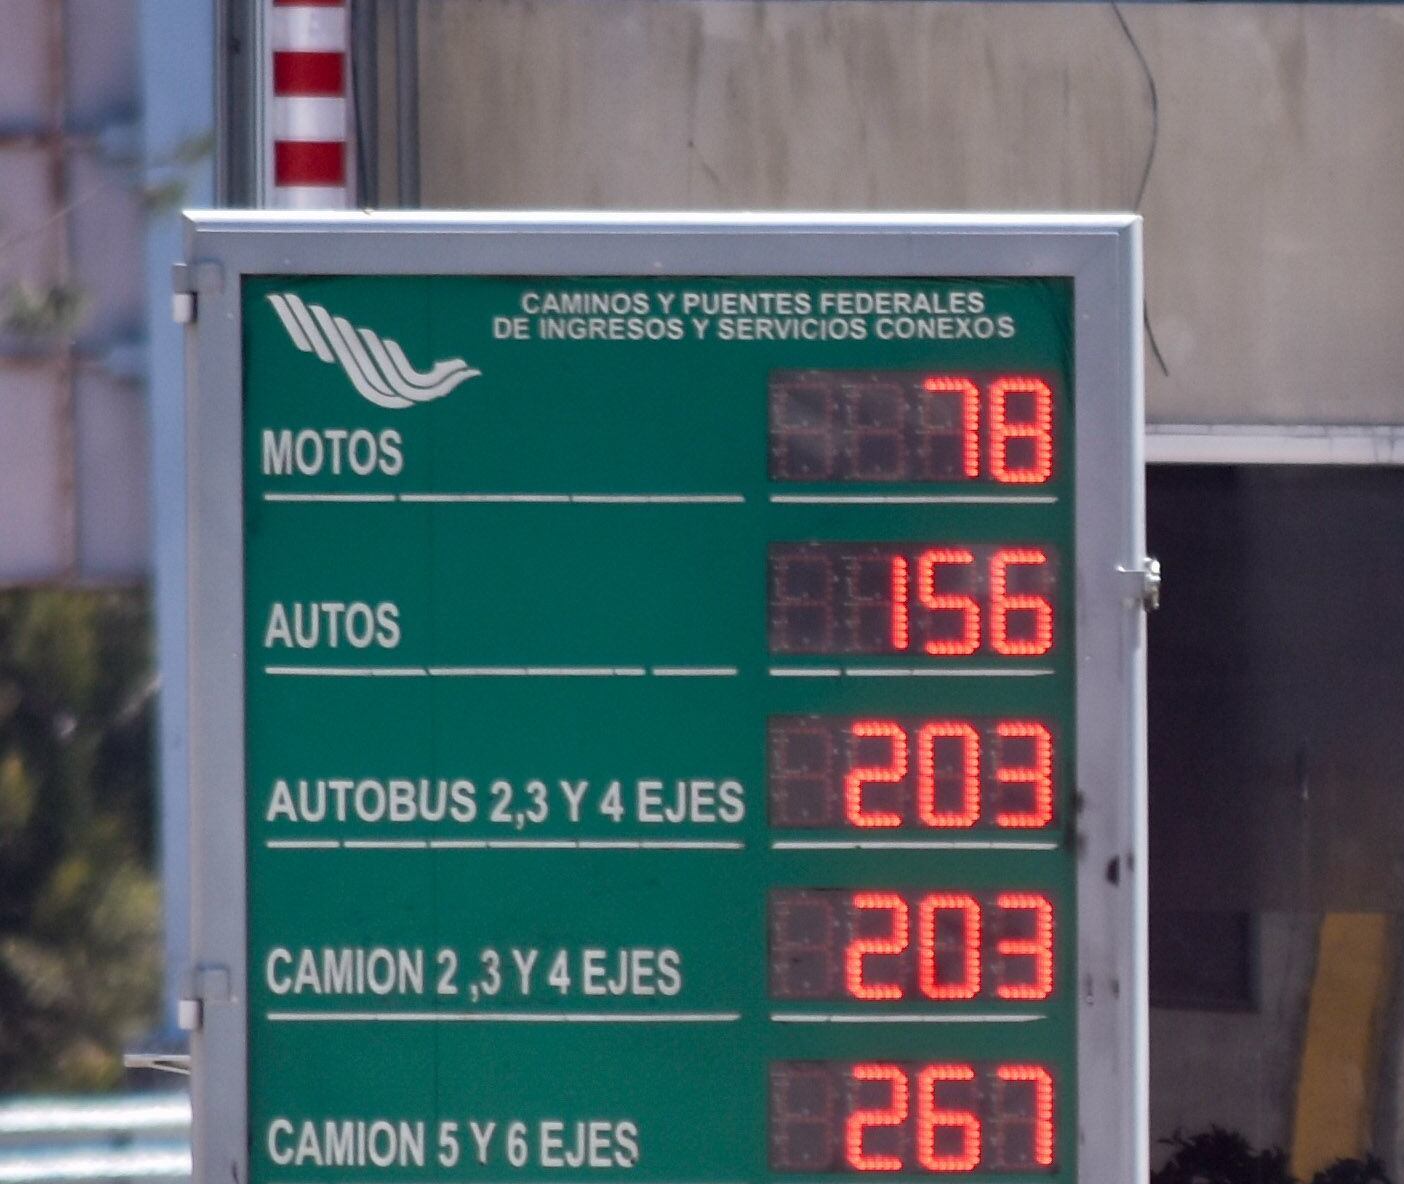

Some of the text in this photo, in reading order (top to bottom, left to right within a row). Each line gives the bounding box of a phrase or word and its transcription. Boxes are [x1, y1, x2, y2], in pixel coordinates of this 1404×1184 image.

[494, 316, 1016, 341] DE INGRESOS Y SERVICIOS CONEXOS
[521, 292, 986, 316] CAMINOS Y PUENTES FEDERALES
[262, 429, 405, 477] MOTOS
[925, 378, 1054, 485] 78
[265, 602, 402, 651] AUTOS
[892, 550, 1054, 657] 156
[845, 722, 1054, 829] 203
[266, 779, 747, 831] AUTOBUS 2,3 Y 4 EJES
[266, 947, 426, 997] CAMION
[512, 949, 540, 996] Y
[548, 949, 573, 996] 4
[583, 949, 684, 998] EJES
[846, 894, 1055, 1001] 203
[268, 1118, 640, 1170] CAMION 5 Y 6 EJES
[846, 1065, 1055, 1173] 267
